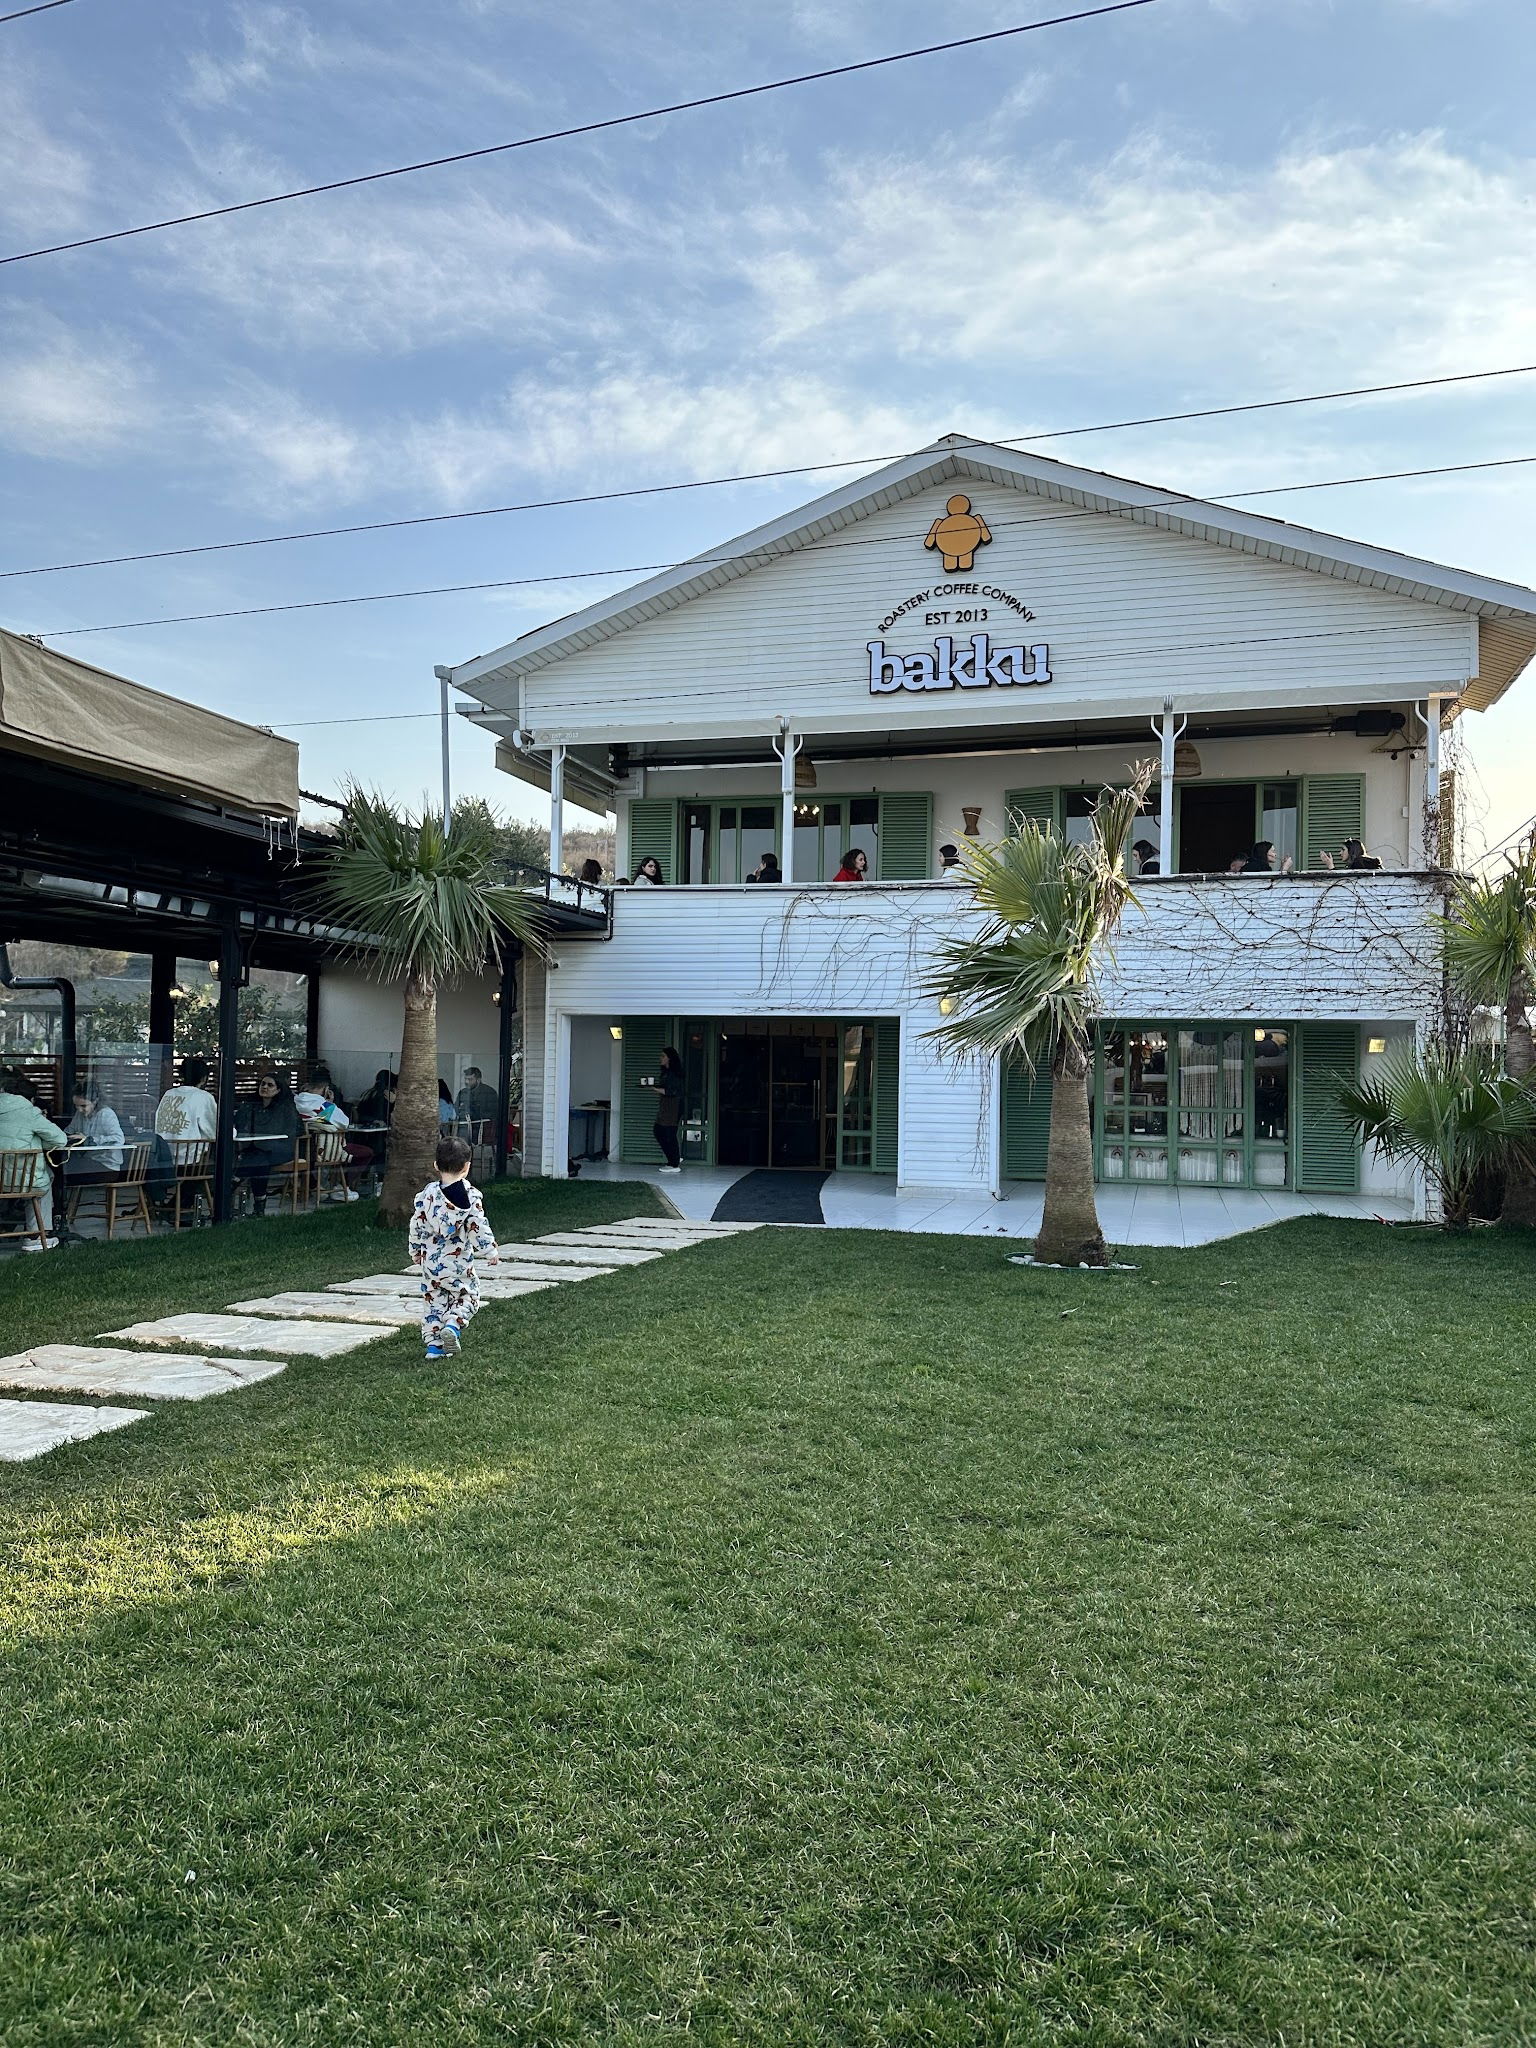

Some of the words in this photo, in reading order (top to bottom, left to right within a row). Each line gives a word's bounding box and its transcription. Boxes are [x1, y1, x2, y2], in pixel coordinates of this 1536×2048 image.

[878, 590, 930, 634] ROASTERY
[933, 583, 980, 598] COFFEE
[982, 585, 1037, 623] COMPANY
[925, 611, 951, 626] EST
[955, 608, 989, 624] 2013
[867, 633, 1053, 695] bakku
